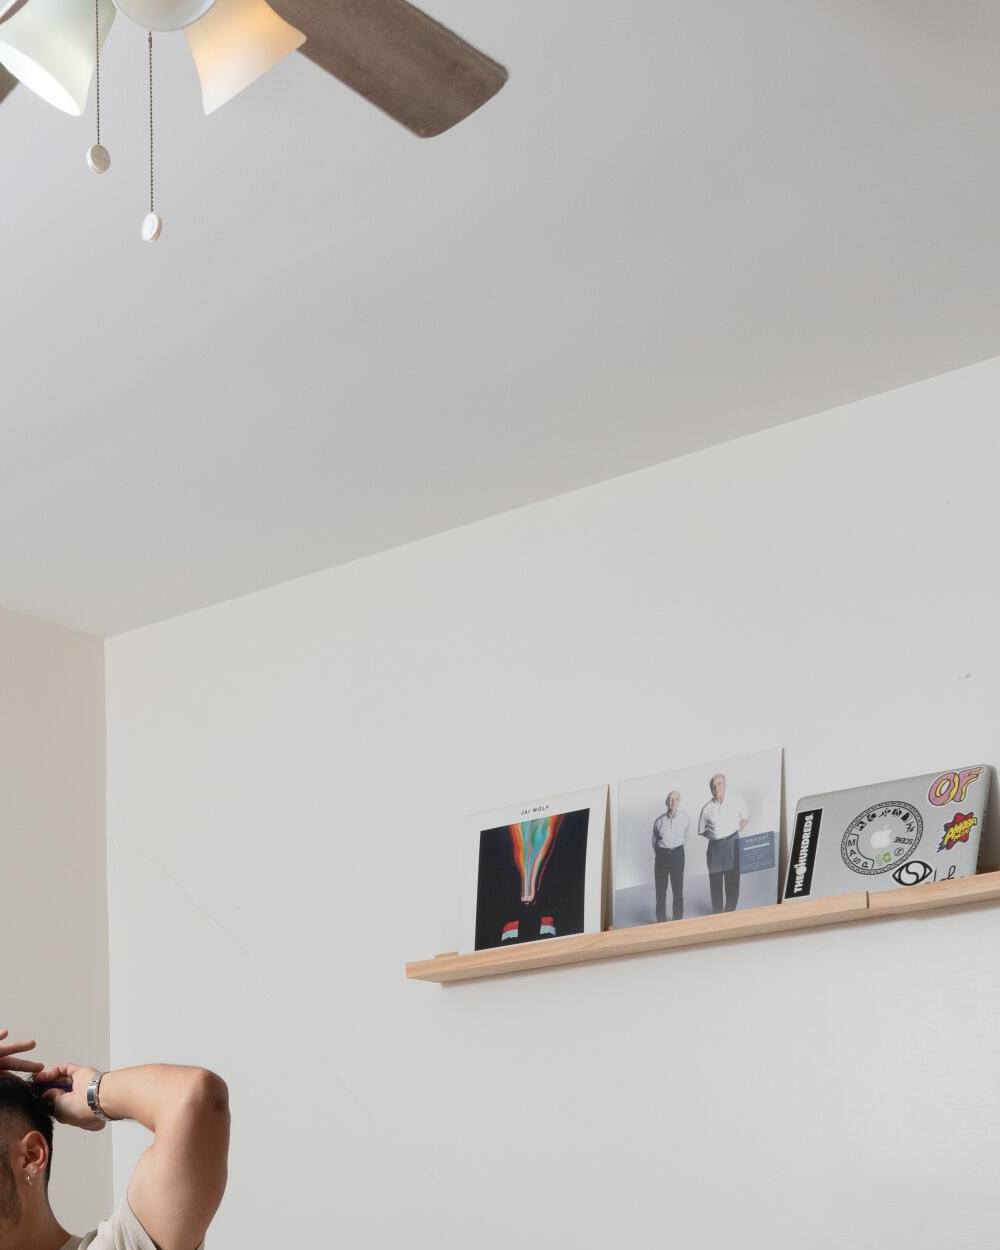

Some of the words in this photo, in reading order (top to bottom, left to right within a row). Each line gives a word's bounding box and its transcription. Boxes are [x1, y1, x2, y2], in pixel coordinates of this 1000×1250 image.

[928, 767, 985, 806] OF
[532, 804, 549, 812] WOLF
[793, 873, 804, 893] THE
[799, 812, 815, 869] HUNDREDS
[893, 836, 913, 845] SCENE
